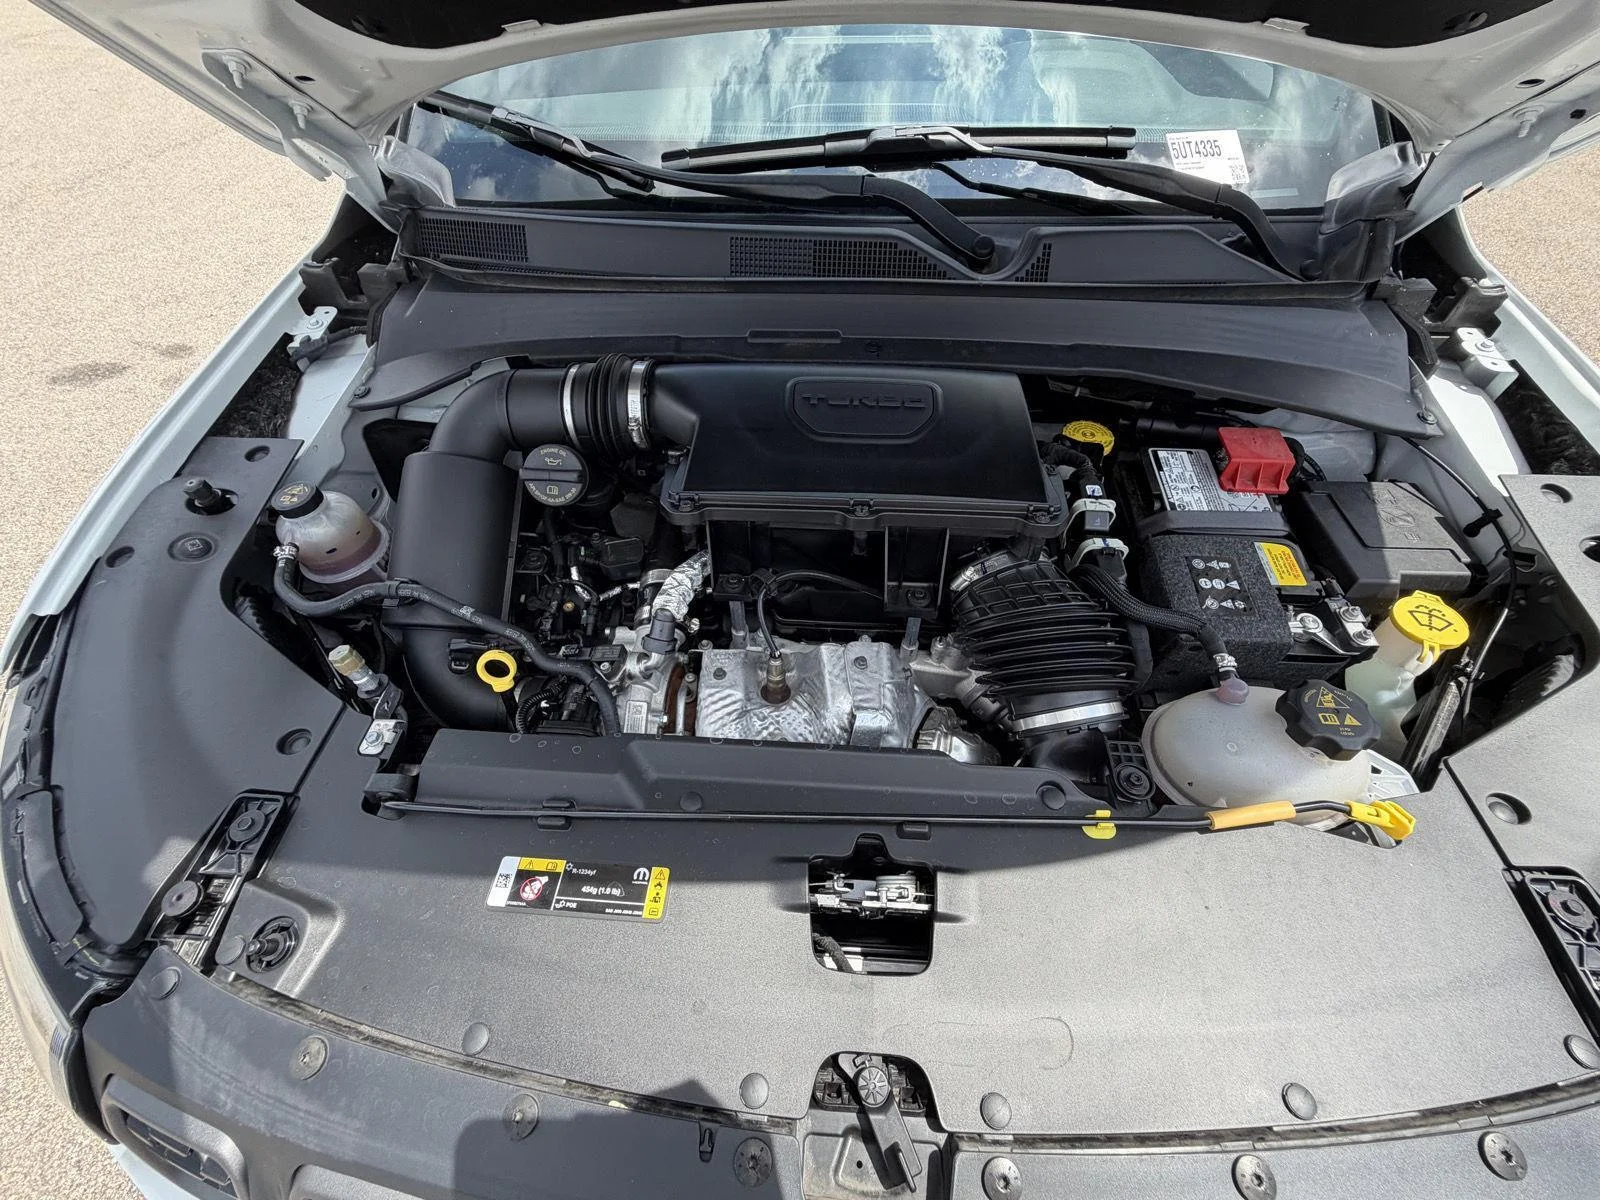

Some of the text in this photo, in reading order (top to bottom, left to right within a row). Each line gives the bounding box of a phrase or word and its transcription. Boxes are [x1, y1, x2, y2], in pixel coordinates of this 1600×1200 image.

[1170, 139, 1222, 160] 5UT4335
[801, 393, 927, 409] TURBO
[540, 447, 567, 457] ENGINE OIL
[572, 868, 597, 877] R-1234yf
[581, 885, 598, 895] 454g
